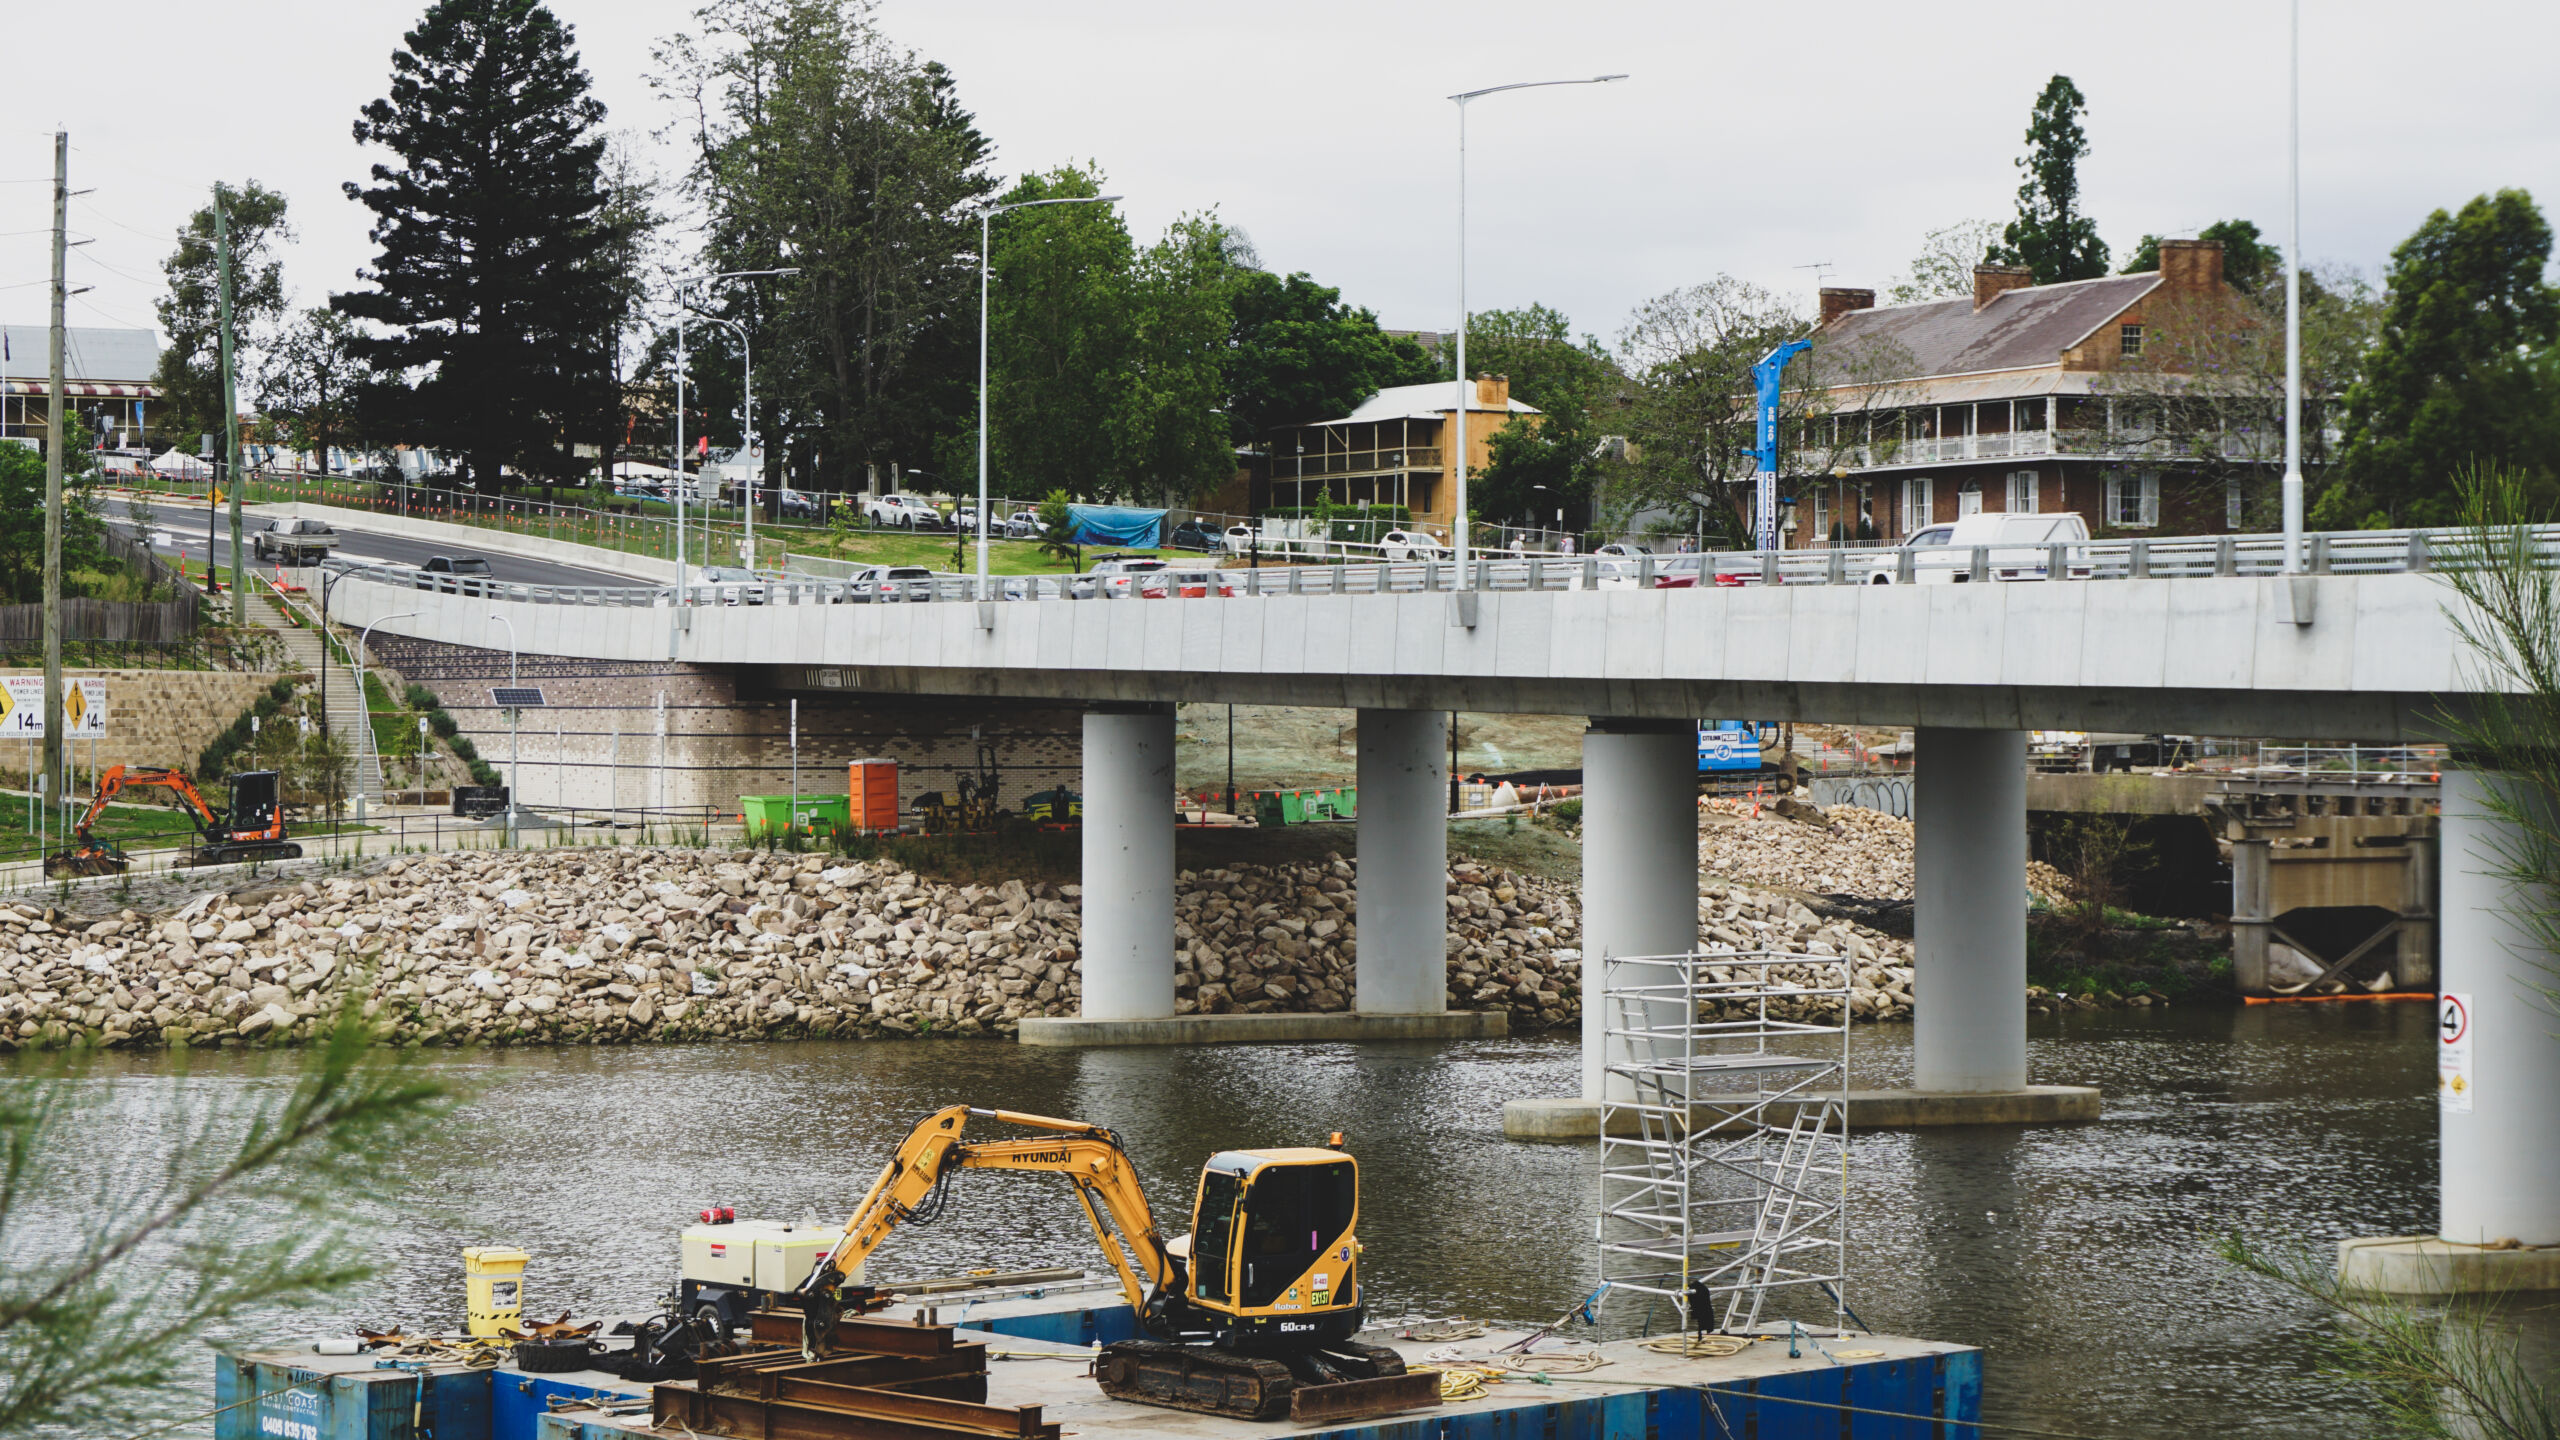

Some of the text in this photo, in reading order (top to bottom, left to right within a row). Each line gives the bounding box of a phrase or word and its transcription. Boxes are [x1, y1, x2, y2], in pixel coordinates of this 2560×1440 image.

[1767, 406, 1775, 441] SR 20
[9, 679, 43, 687] WARNING
[84, 680, 105, 688] WARNING
[18, 712, 43, 730] 14m
[87, 712, 105, 730] 14m
[2442, 1005, 2457, 1034] 4
[1012, 1151, 1072, 1163] HYUNDAI
[1312, 1290, 1329, 1305] EX137
[262, 1390, 318, 1410] EAST COAST
[283, 1403, 319, 1416] CONTRACTING
[262, 1416, 282, 1436] 0405
[300, 1423, 317, 1440] 762
